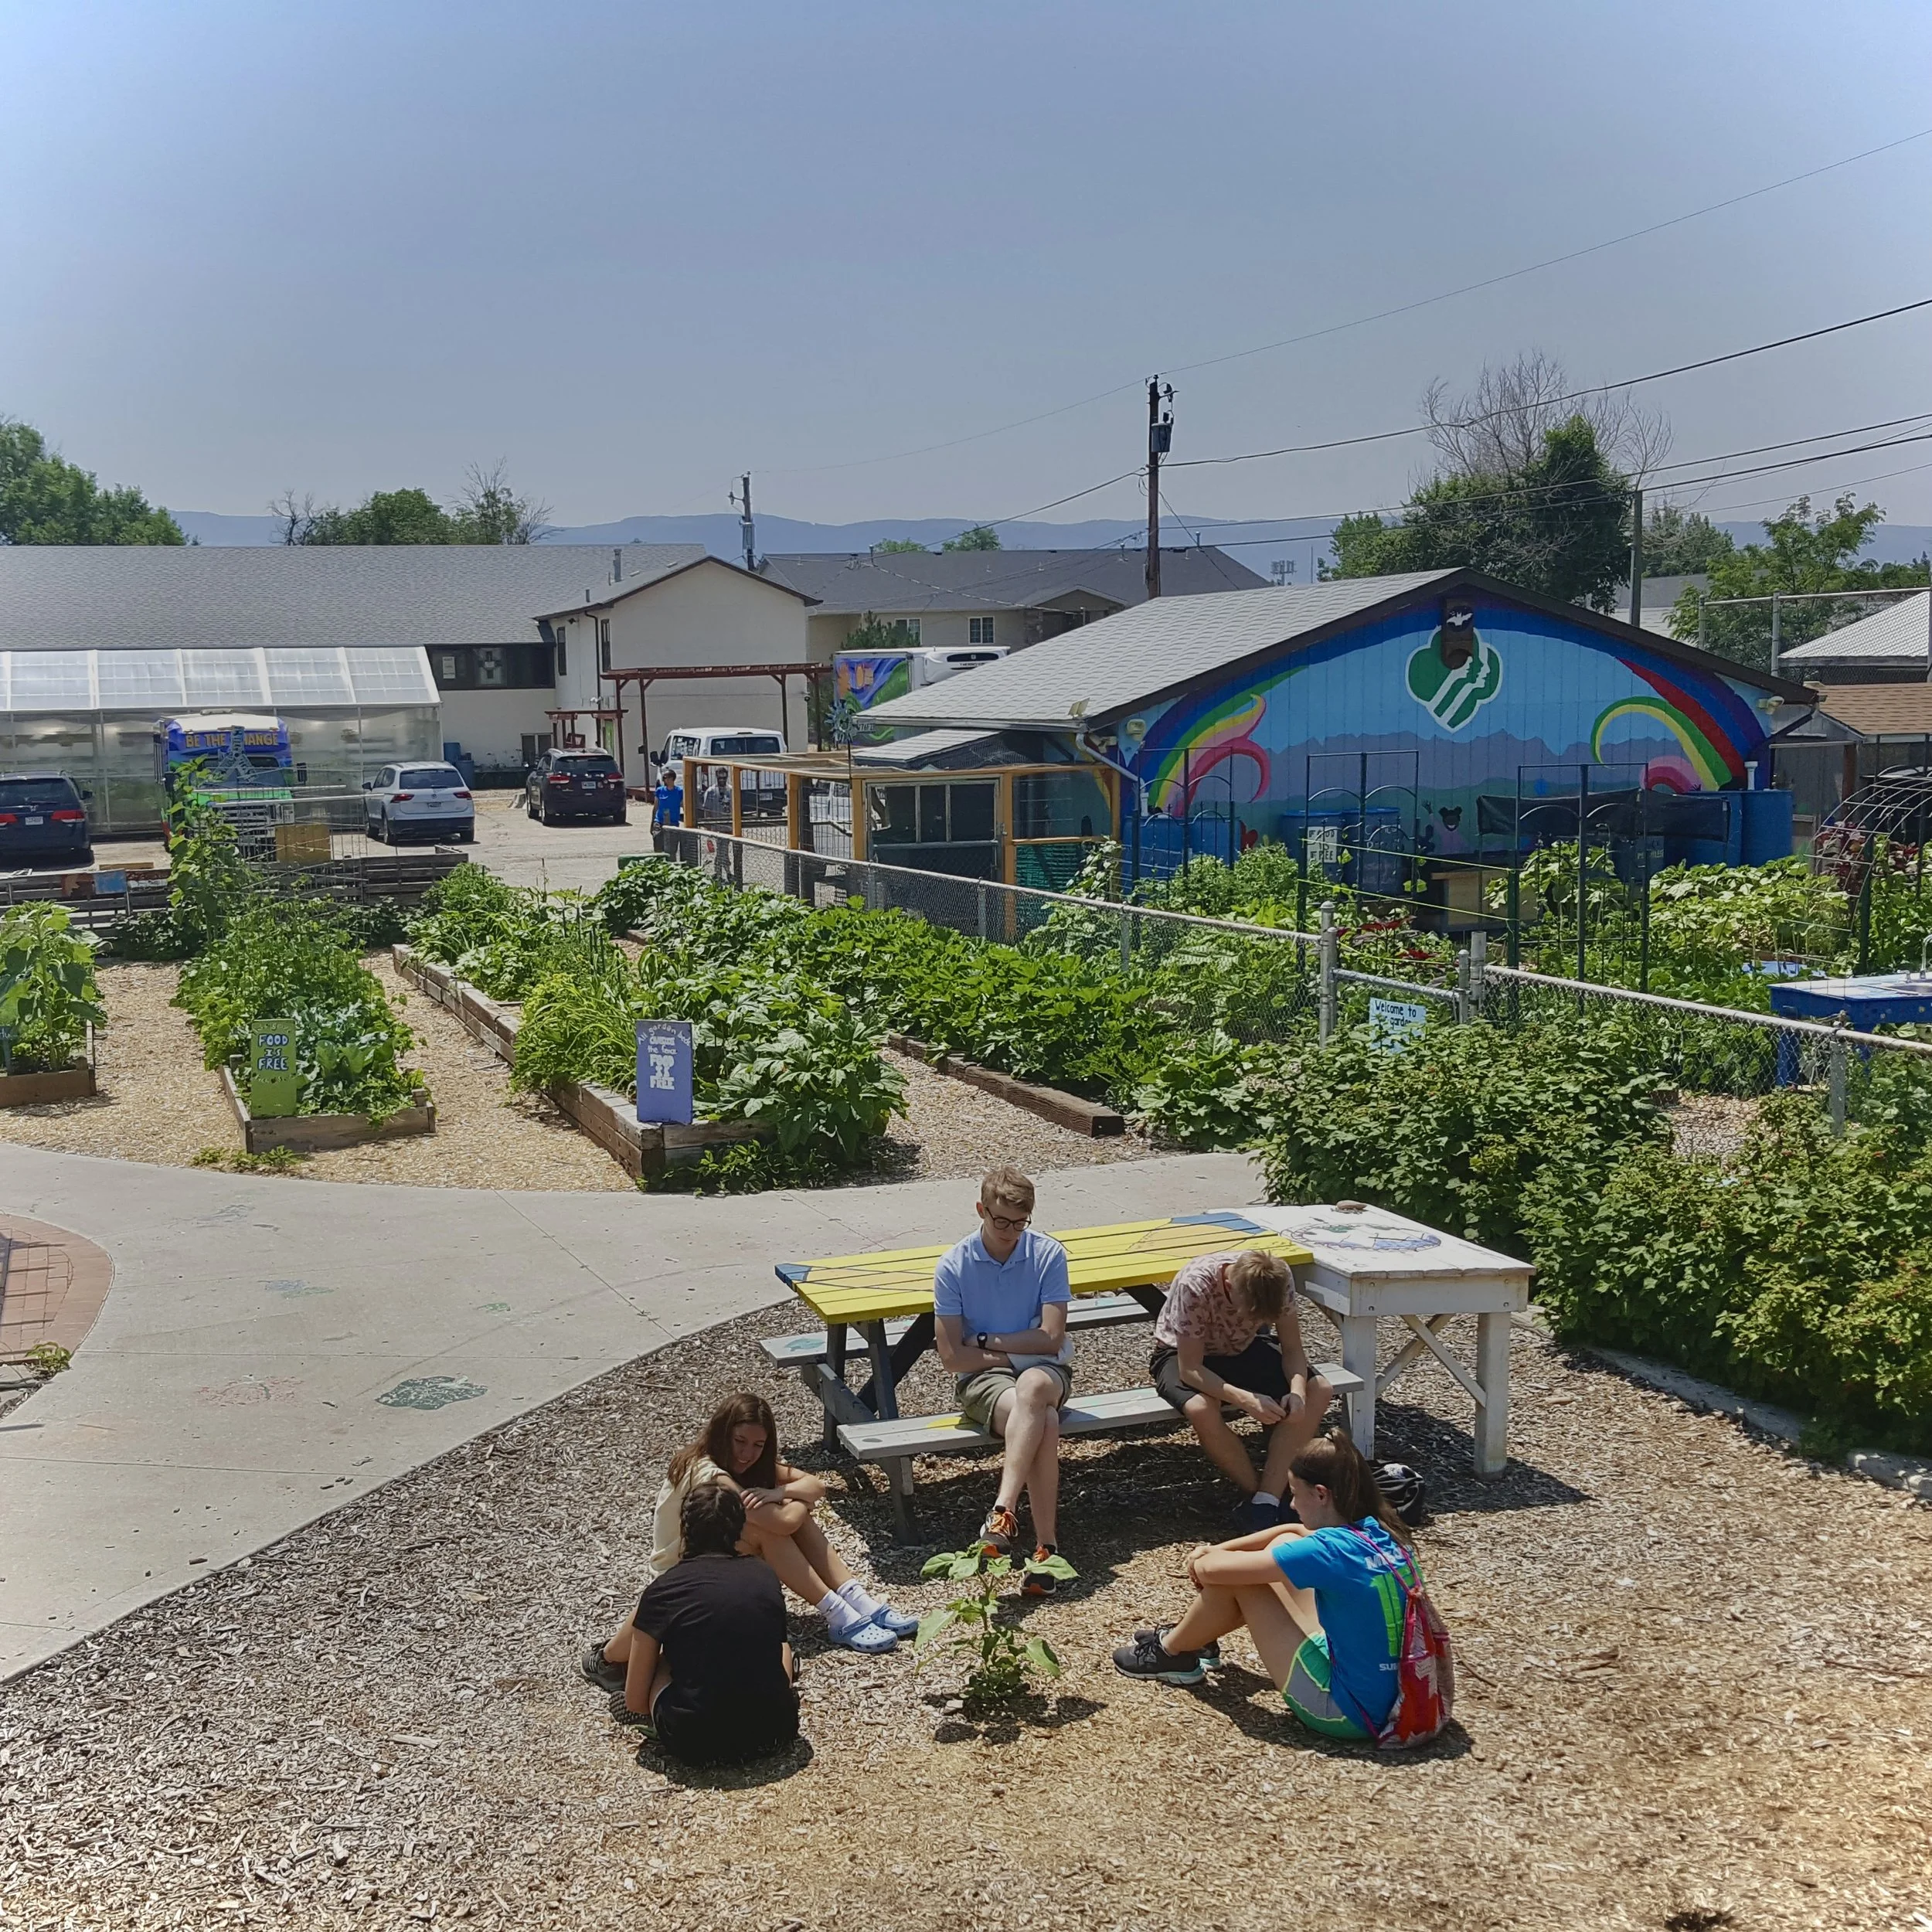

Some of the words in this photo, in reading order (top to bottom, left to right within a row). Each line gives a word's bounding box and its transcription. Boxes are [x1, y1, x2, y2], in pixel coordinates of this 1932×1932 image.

[185, 735, 200, 748] BE
[205, 734, 226, 747] THE
[1310, 851, 1333, 860] FREE
[1375, 1000, 1403, 1015] Welcome
[1408, 1005, 1417, 1018] to
[258, 1035, 288, 1046] FOOD
[638, 1032, 647, 1045] All
[649, 1023, 677, 1036] garden
[264, 1049, 281, 1057] IS
[648, 1045, 658, 1054] the
[257, 1057, 288, 1070] FREE
[650, 1054, 675, 1067] FOOD
[650, 1075, 675, 1090] FREE
